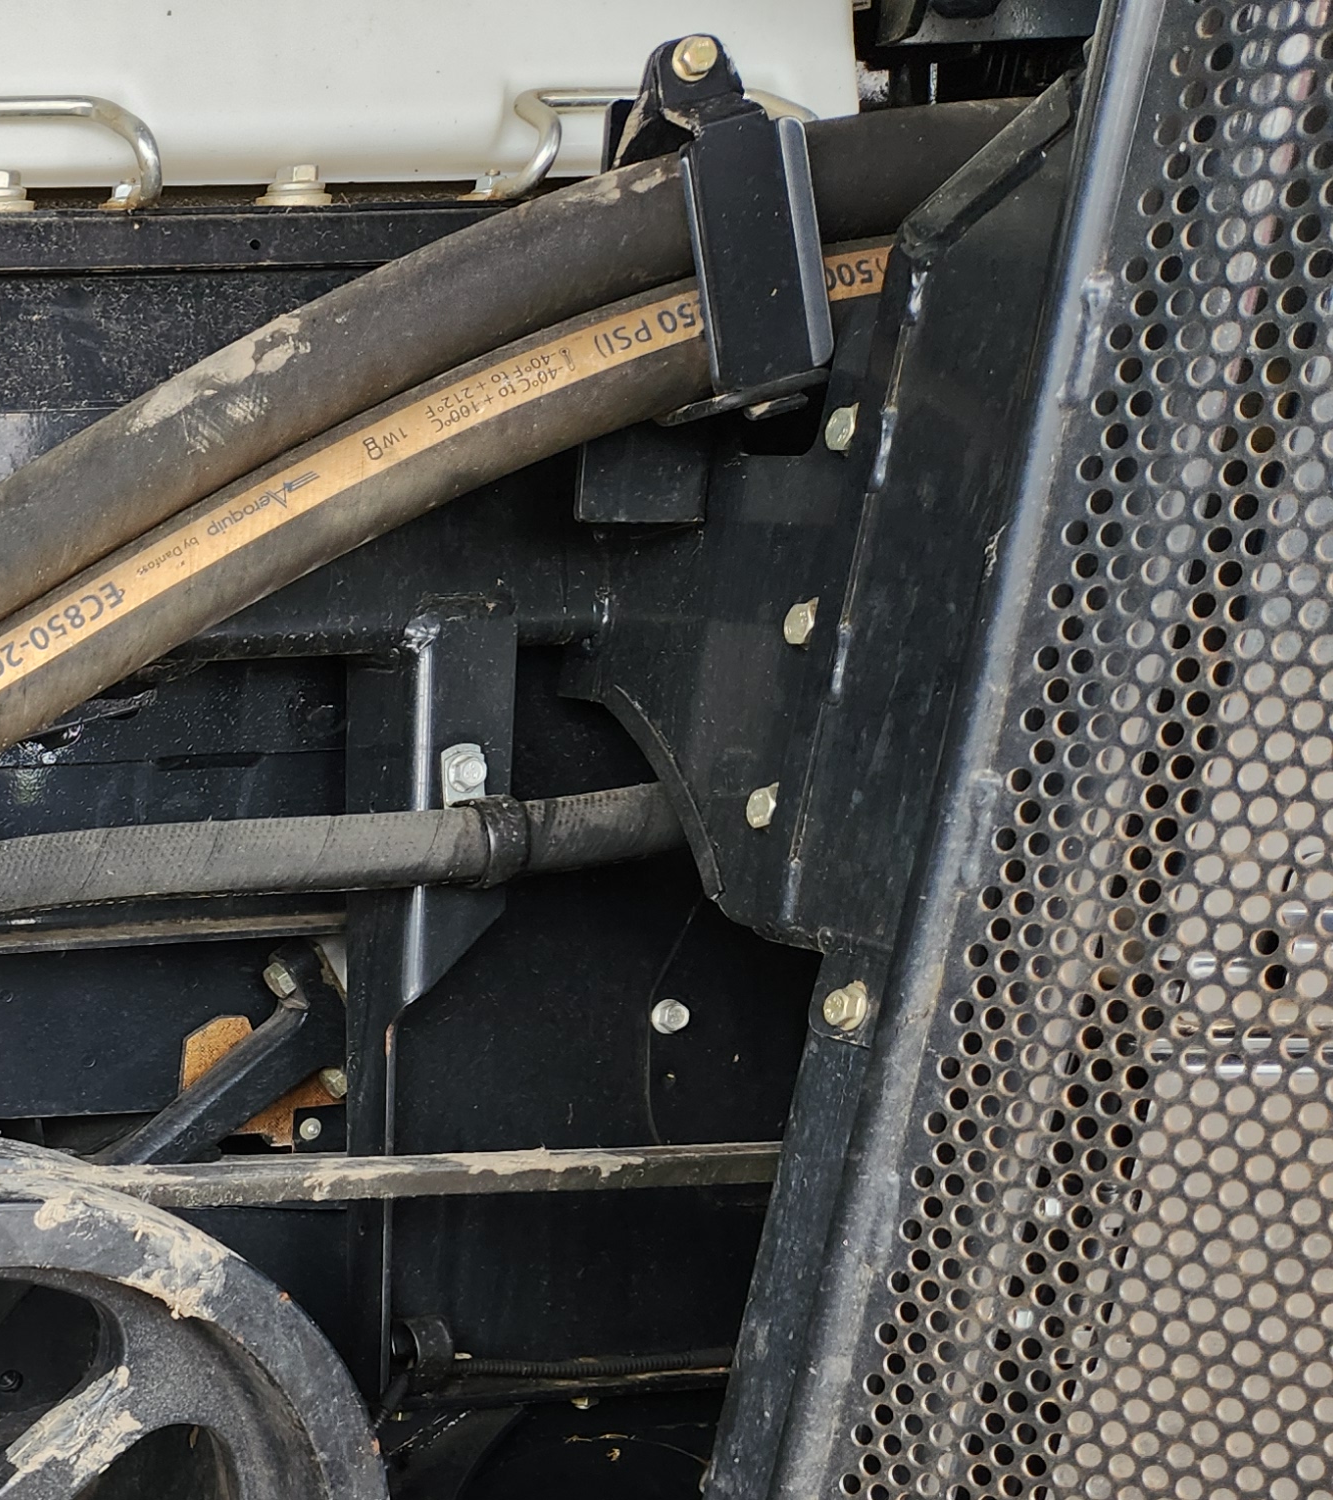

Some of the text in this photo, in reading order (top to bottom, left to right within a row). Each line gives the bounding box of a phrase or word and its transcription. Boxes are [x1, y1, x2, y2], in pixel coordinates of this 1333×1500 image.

[593, 316, 653, 358] PSI)
[489, 369, 510, 387] to
[496, 382, 517, 400] to
[136, 482, 298, 577] Aeroquip by Danfoss
